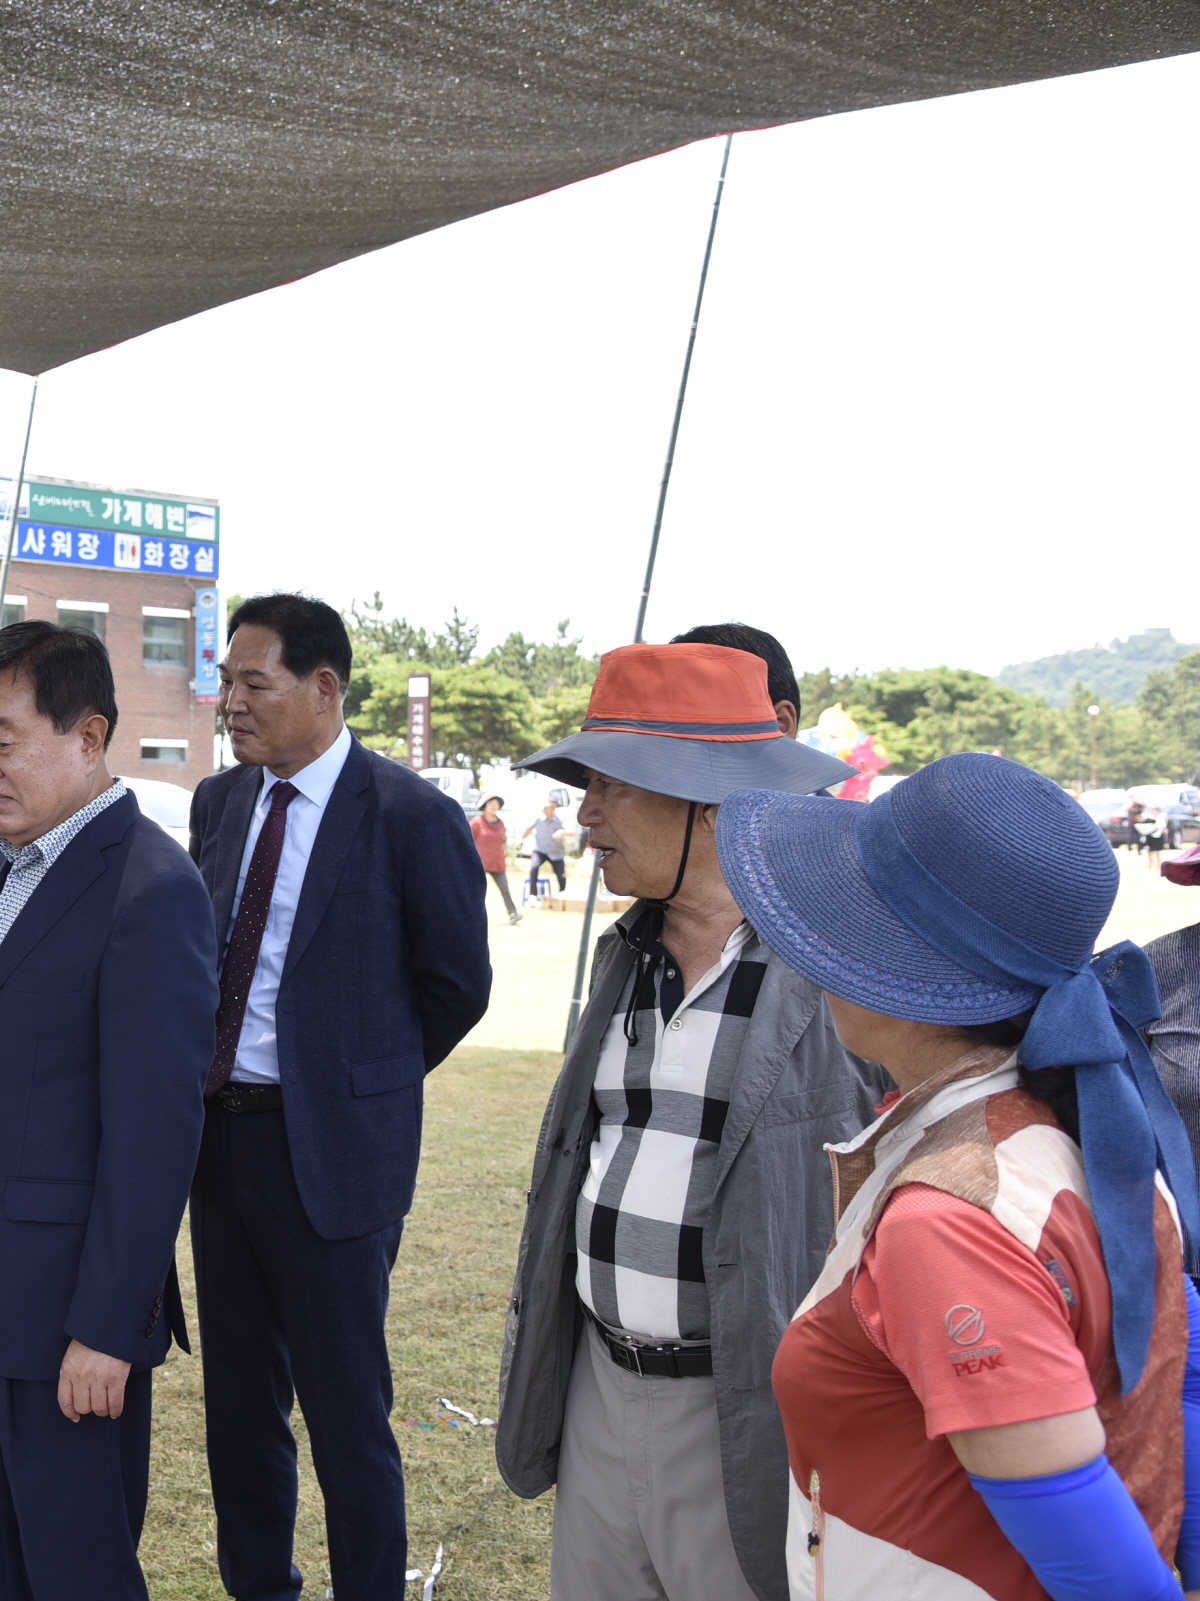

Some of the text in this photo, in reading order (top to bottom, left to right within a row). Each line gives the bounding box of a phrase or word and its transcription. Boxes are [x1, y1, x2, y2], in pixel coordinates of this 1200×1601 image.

[102, 497, 185, 532] 가계해변
[22, 527, 215, 573] 샤워장 화장실
[951, 1354, 1008, 1377] PEAK
